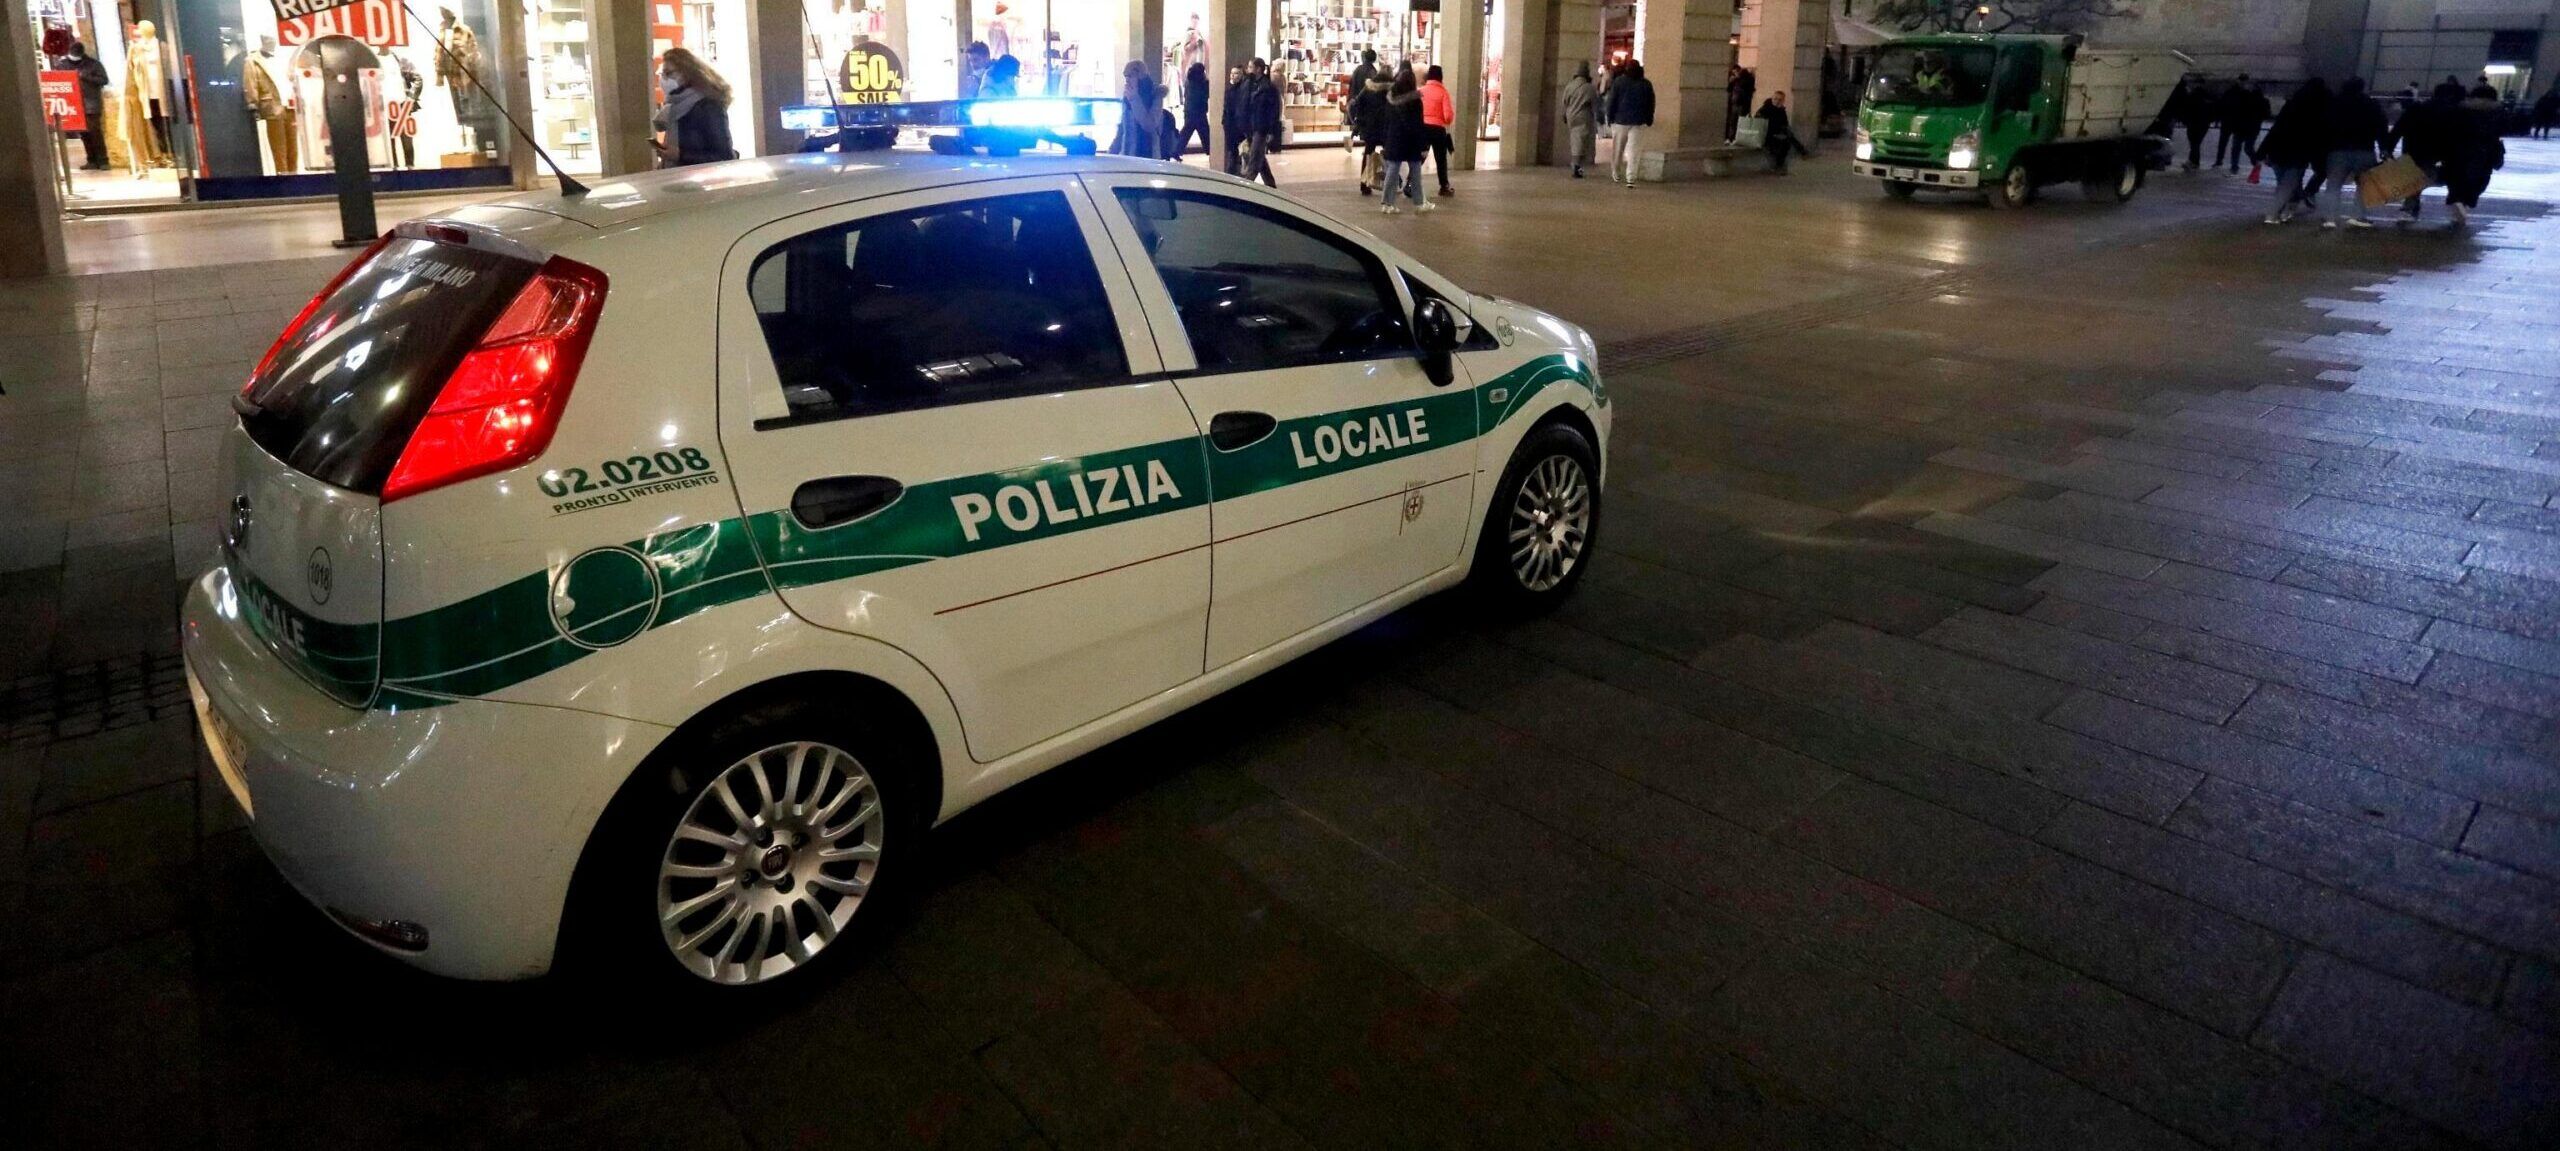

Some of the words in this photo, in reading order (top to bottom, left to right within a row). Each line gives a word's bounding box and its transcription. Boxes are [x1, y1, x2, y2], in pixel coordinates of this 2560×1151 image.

[282, 0, 405, 45] SALDI
[848, 51, 902, 91] 50%
[421, 261, 477, 288] MILANO
[537, 447, 710, 498] 02.0208
[951, 459, 1182, 542] POLIZIA
[1290, 408, 1430, 469] LOCALE
[552, 493, 621, 514] PRONTO
[629, 475, 720, 499] INTERVENTO
[310, 562, 331, 591] 1018
